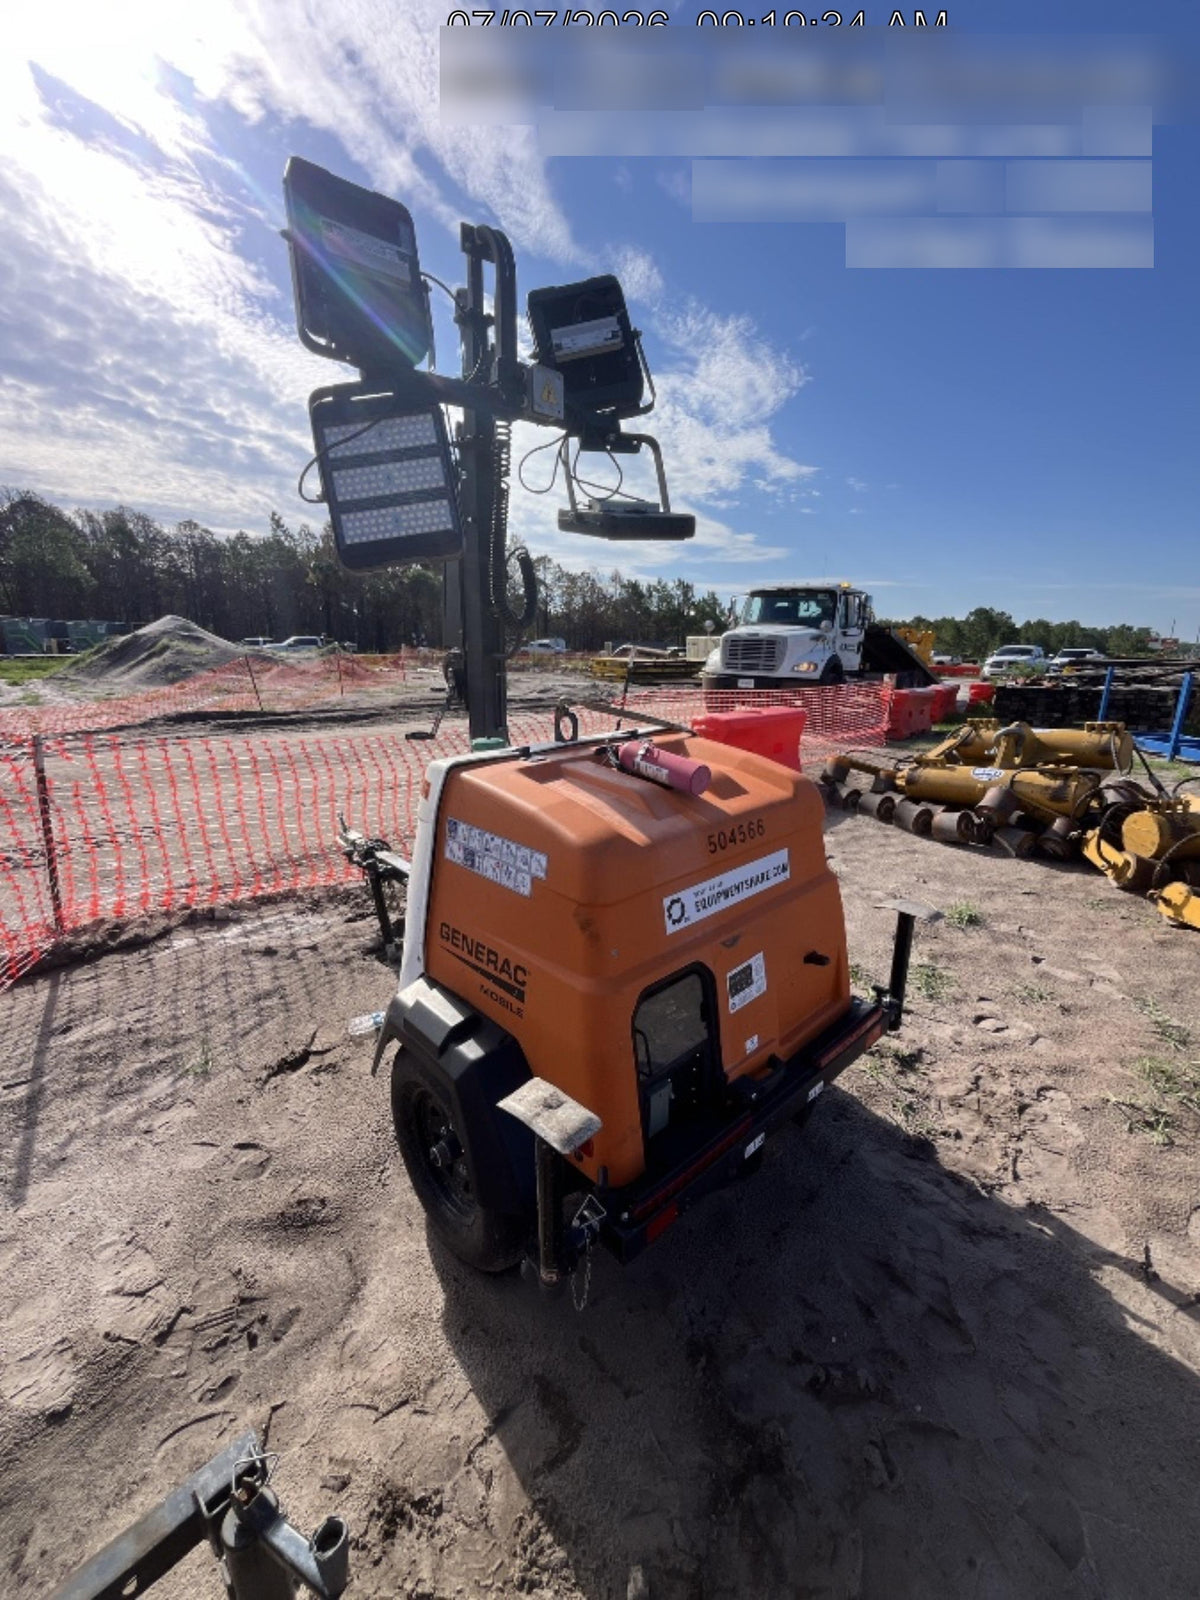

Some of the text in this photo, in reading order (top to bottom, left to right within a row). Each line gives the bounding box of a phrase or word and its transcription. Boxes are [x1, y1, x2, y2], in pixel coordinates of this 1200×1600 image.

[707, 818, 766, 854] 504566
[440, 921, 528, 987] GENERAC
[479, 984, 524, 1019] MOBILE
